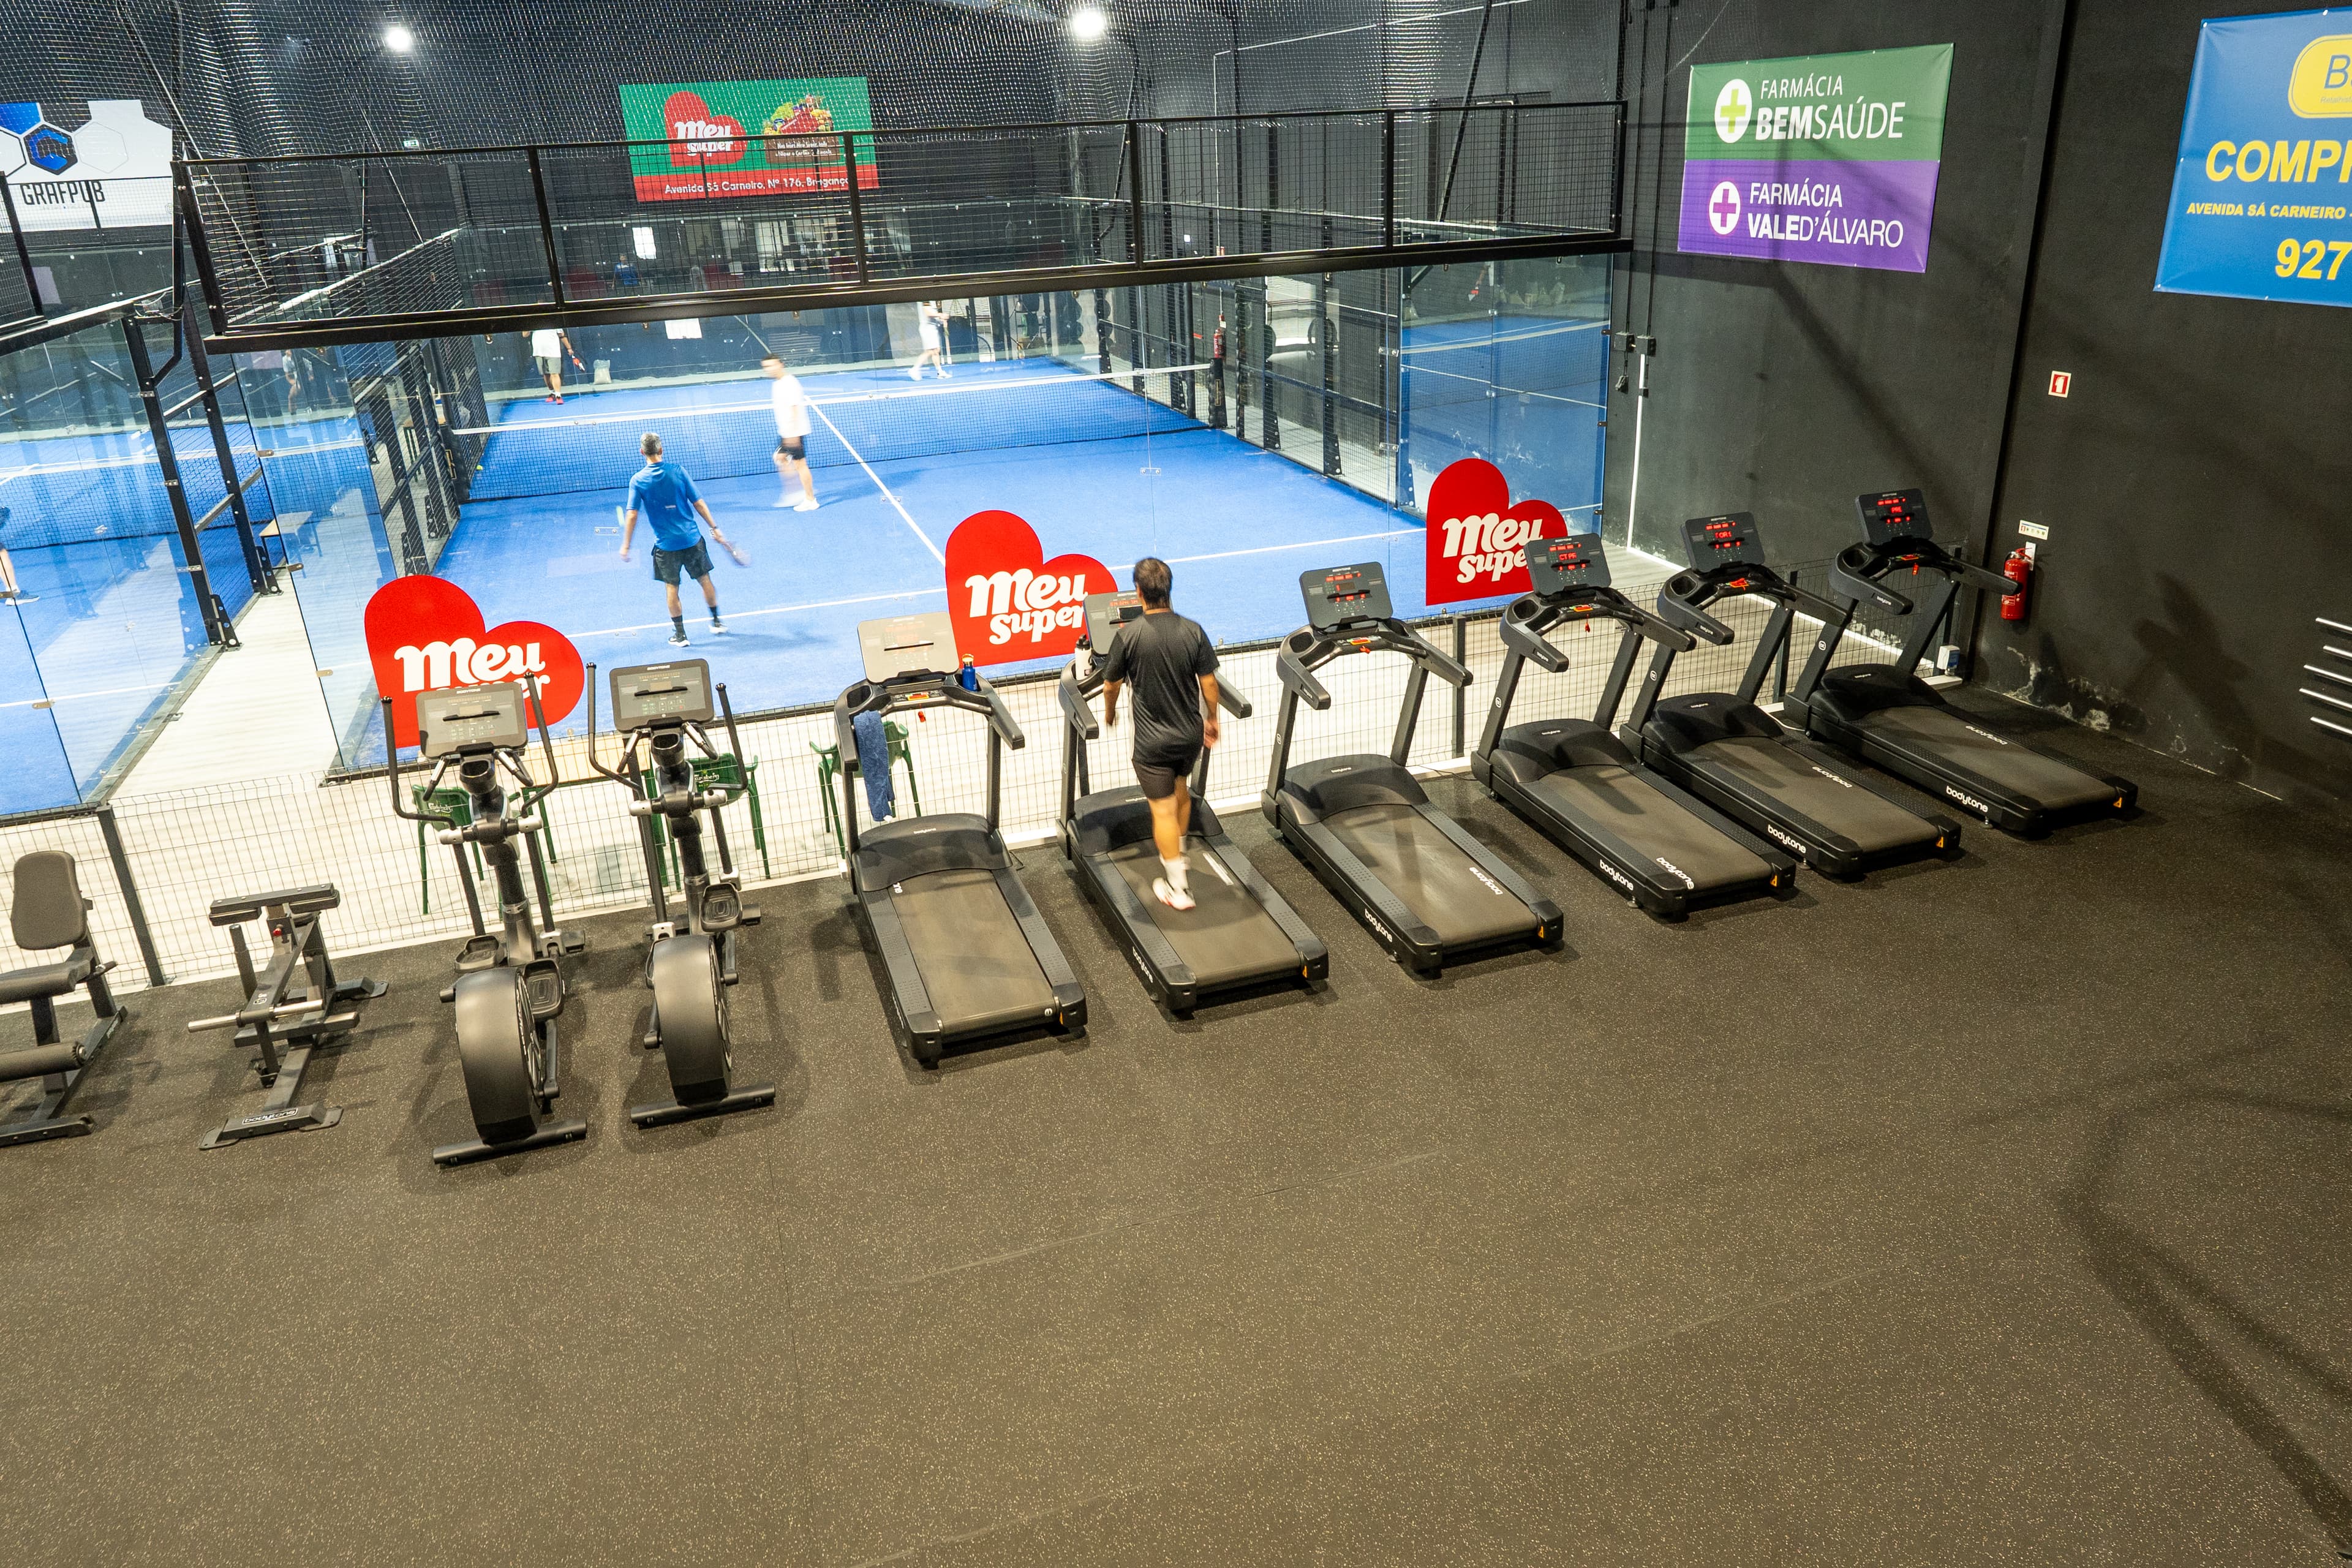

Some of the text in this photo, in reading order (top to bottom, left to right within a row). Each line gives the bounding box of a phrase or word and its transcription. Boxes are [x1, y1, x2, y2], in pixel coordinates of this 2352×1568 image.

[1760, 72, 1843, 99] FARMÁCIA
[674, 120, 734, 140] Meu
[1755, 96, 1906, 140] BEMSAÚDE
[20, 181, 106, 205] GRAFPUB
[665, 184, 704, 194] Avenida
[706, 182, 719, 192] Sá
[1749, 178, 1842, 208] FARMÁCIA
[2187, 202, 2346, 219] AVENIDA SÁ CARNEIRO
[1747, 210, 1904, 248] VALED'ÁLVARO
[2275, 238, 2352, 281] 927
[1442, 513, 1544, 558] Meu
[1457, 548, 1529, 584] supe
[965, 568, 1088, 617] Meu
[989, 605, 1084, 645] super
[394, 637, 546, 692] Meu
[1966, 725, 2008, 745] bodytone
[1812, 766, 1853, 788] bodytone
[1946, 785, 1988, 812] bodytone
[1768, 824, 1806, 854] bodytone
[1469, 867, 1504, 895] bodytone
[1599, 859, 1634, 891] bodytone
[1656, 857, 1695, 890] bodytone
[1365, 908, 1393, 943] bodytone
[244, 1110, 296, 1123] bodytone
